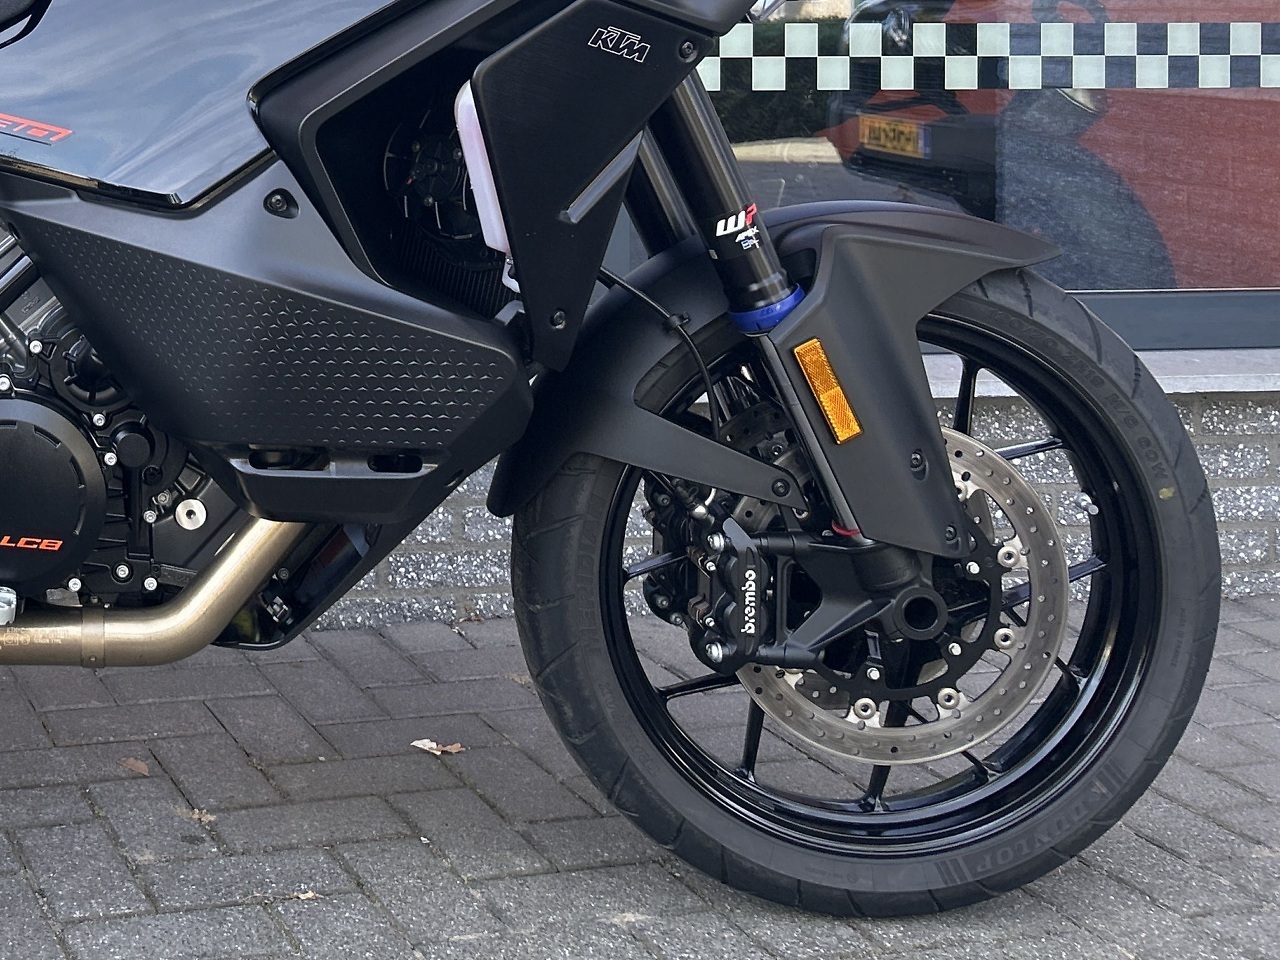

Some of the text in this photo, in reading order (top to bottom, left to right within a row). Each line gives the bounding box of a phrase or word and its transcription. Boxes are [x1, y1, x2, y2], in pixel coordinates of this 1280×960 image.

[588, 26, 651, 63] KTM
[0, 535, 64, 551] LC8
[740, 569, 757, 635] brembo
[976, 800, 1089, 872] DUNLOP
